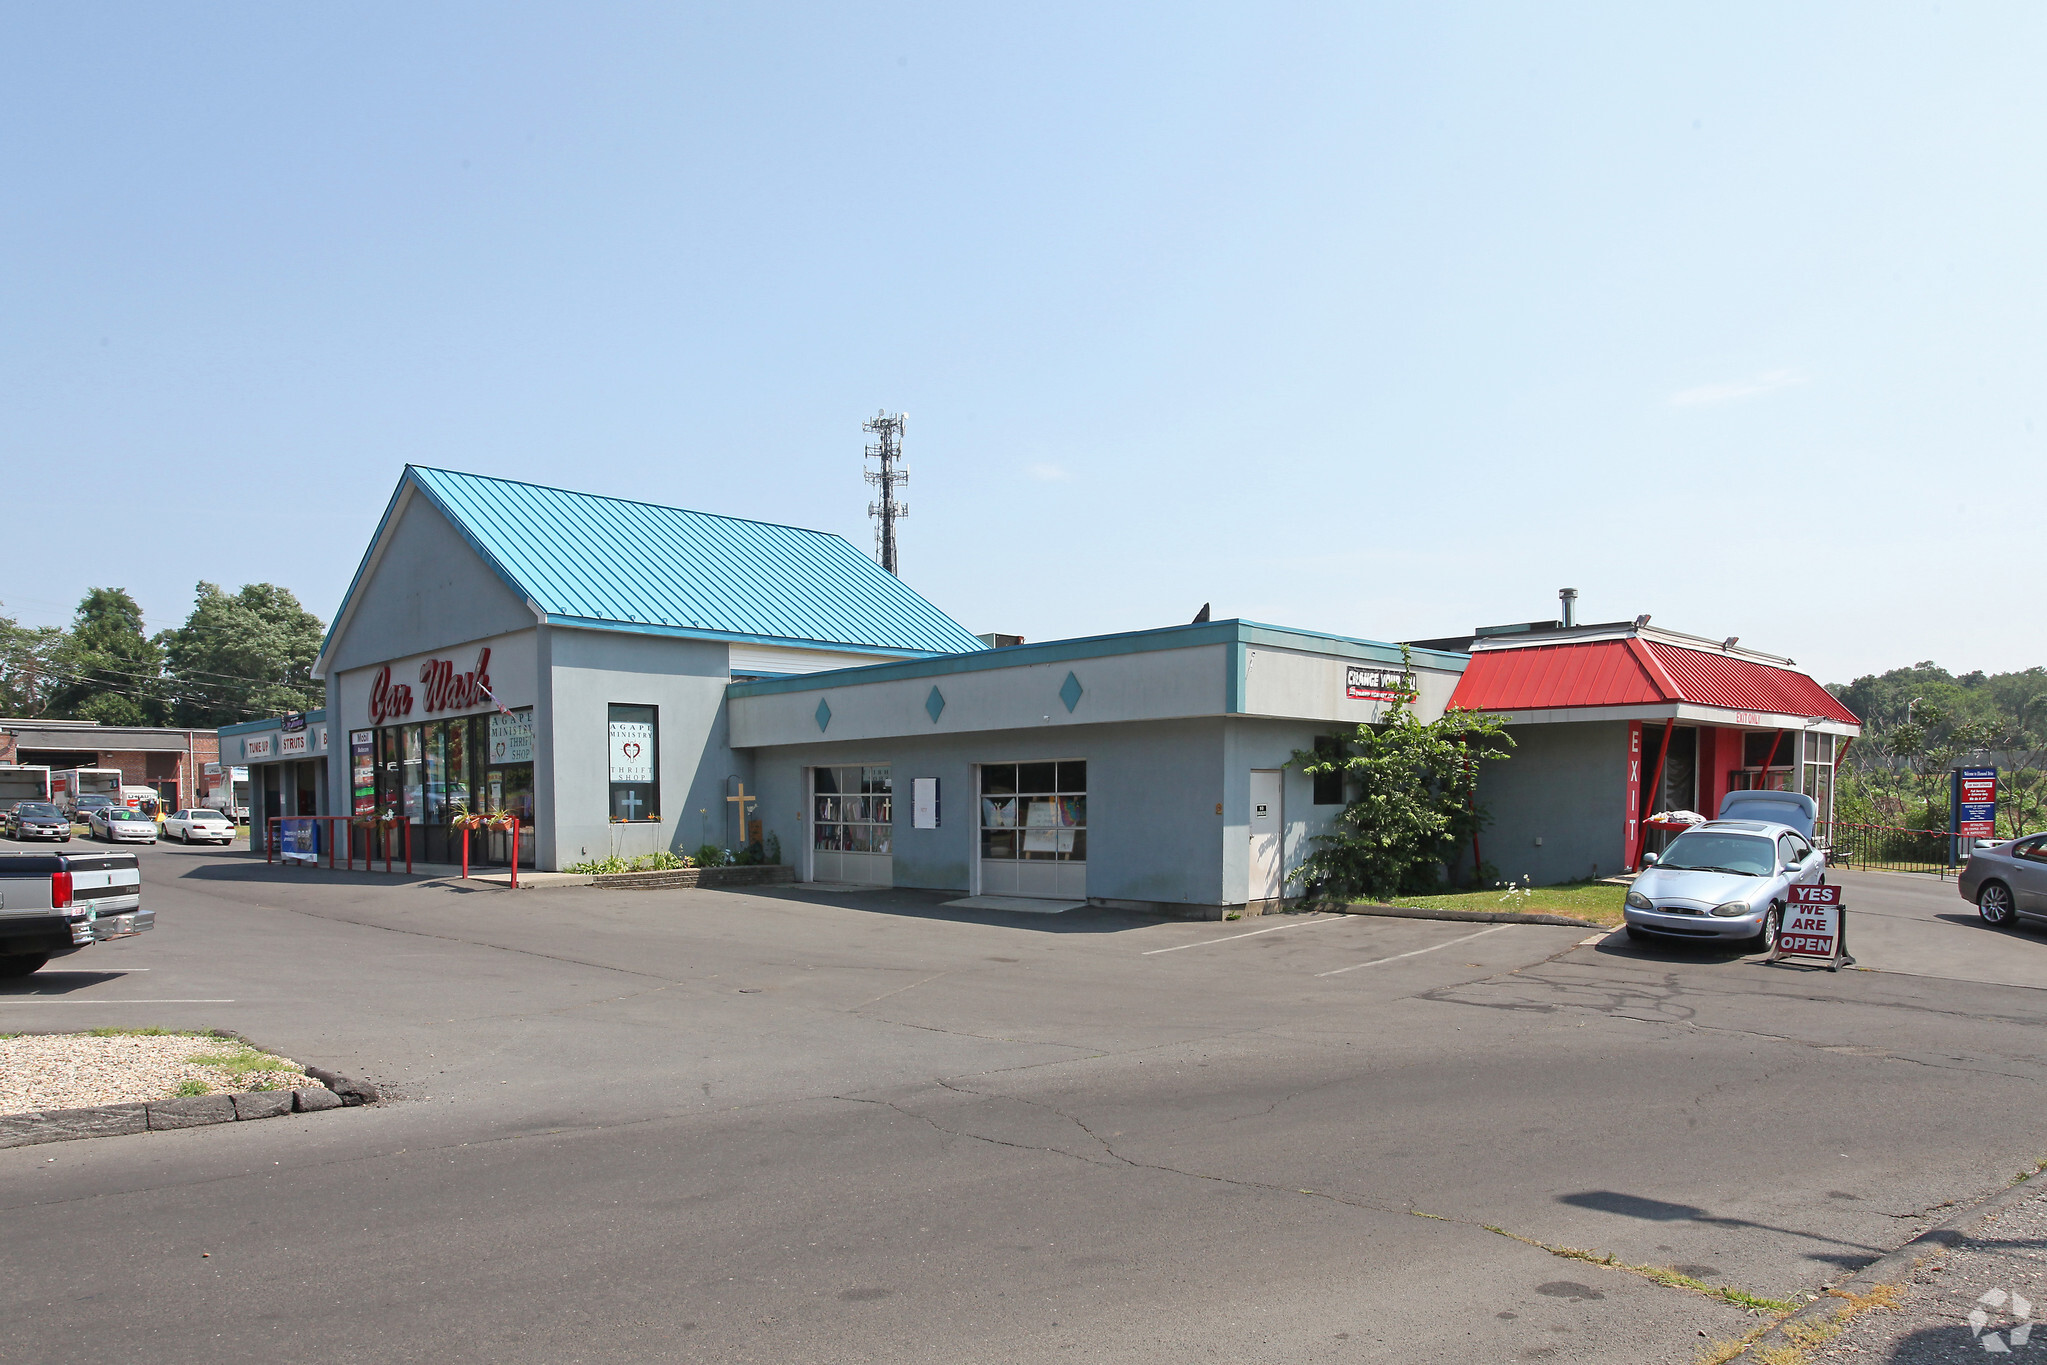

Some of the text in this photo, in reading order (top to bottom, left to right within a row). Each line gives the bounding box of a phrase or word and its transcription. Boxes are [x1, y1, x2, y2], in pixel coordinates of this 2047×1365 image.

[1348, 670, 1380, 687] CHANGE
[368, 648, 492, 725] Car Wash
[492, 712, 532, 726] AGAPE
[1736, 712, 1760, 724] EXIT ONLY
[492, 724, 532, 737] MINISTRY
[249, 740, 268, 754] TUNE UP
[284, 736, 304, 750] STRUTS
[510, 736, 532, 747] THRIFT
[512, 749, 530, 760] SHOP
[1630, 731, 1638, 840] EXIT
[1796, 888, 1833, 902] YES
[1800, 905, 1824, 915] WE
[1791, 918, 1827, 931] ARE
[1780, 936, 1831, 952] OPEN
